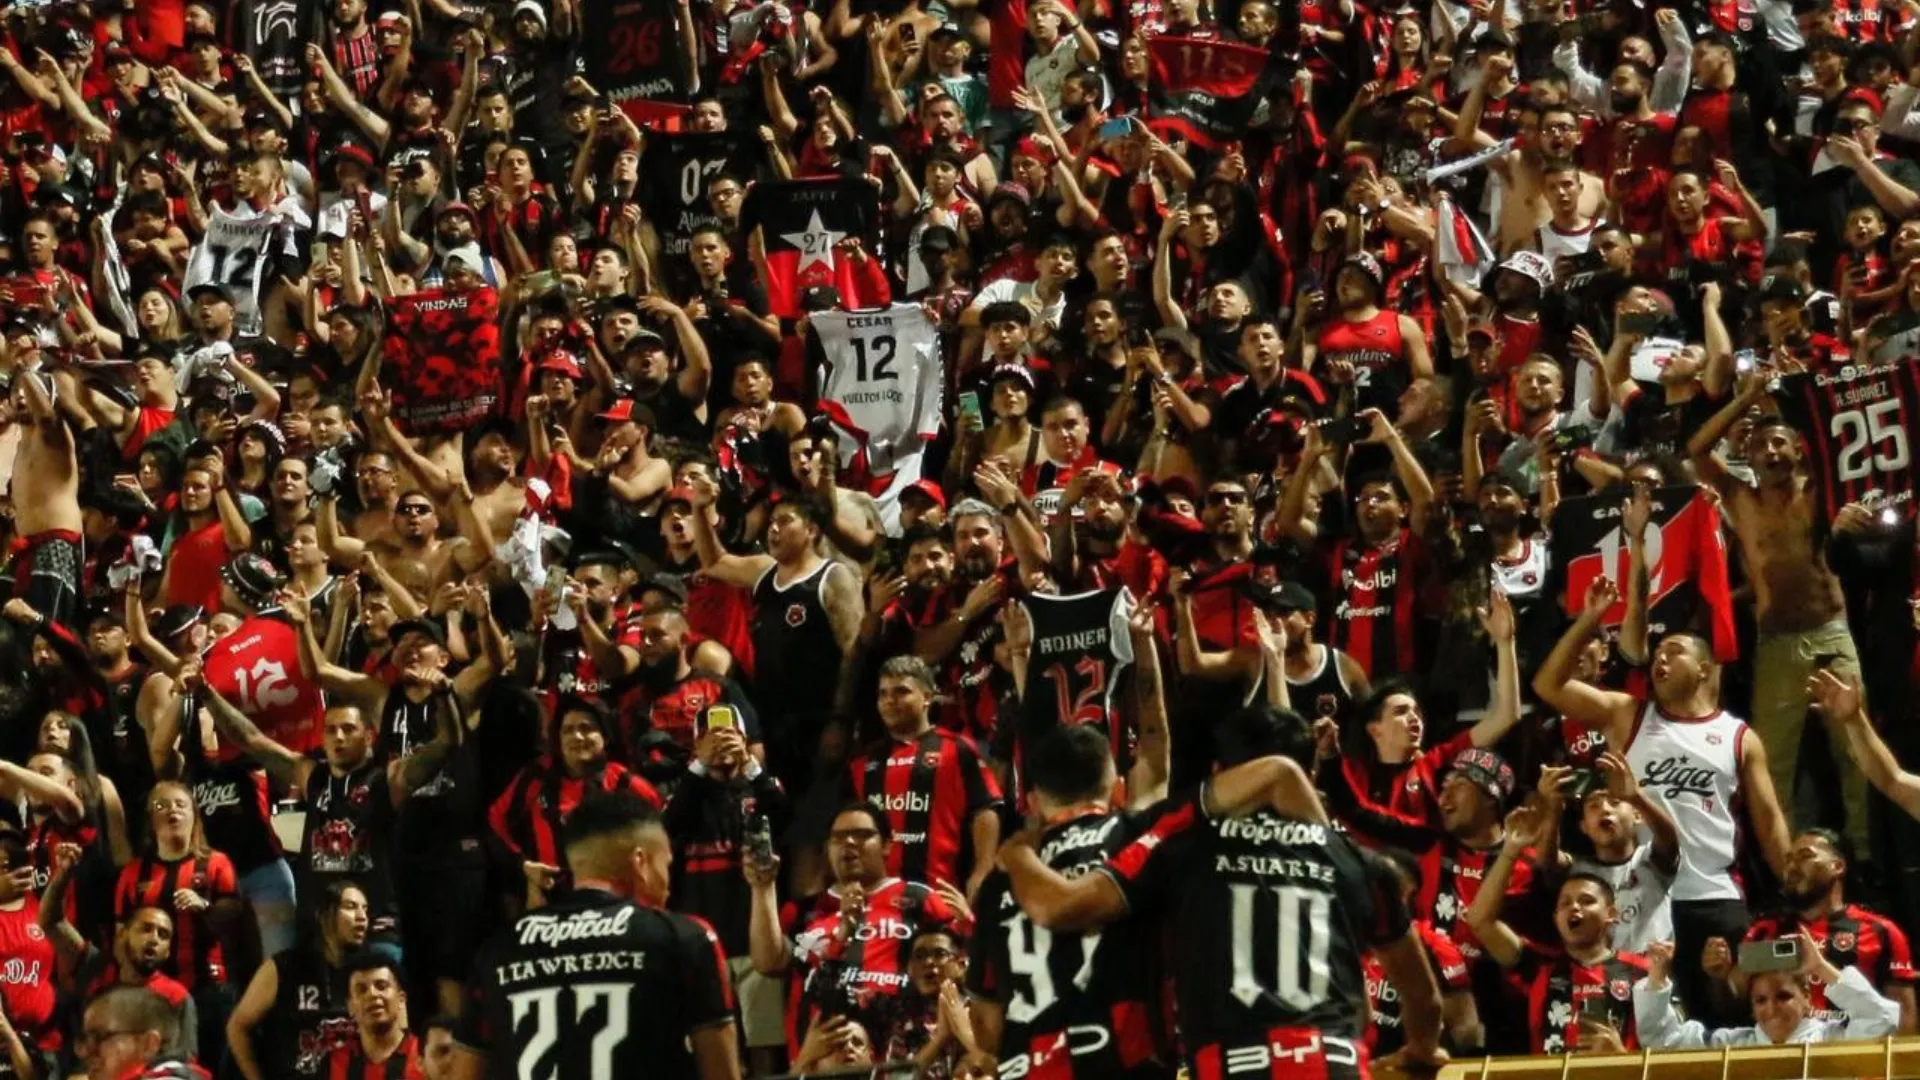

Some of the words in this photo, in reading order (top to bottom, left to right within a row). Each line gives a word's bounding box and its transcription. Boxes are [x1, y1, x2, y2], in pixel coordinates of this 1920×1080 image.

[804, 232, 829, 255] 27
[413, 298, 469, 313] VINDAS
[847, 316, 893, 329] CESAR
[850, 335, 899, 383] 12
[1831, 398, 1910, 483] 25
[234, 657, 301, 714] 12
[1042, 655, 1105, 726] 12
[1639, 756, 1716, 800] Liga
[1215, 854, 1337, 885] A.SUAREZ
[515, 904, 636, 949] Tropical
[1228, 883, 1338, 1013] 10
[299, 983, 320, 1011] 12
[1225, 1033, 1360, 1076] BYD
